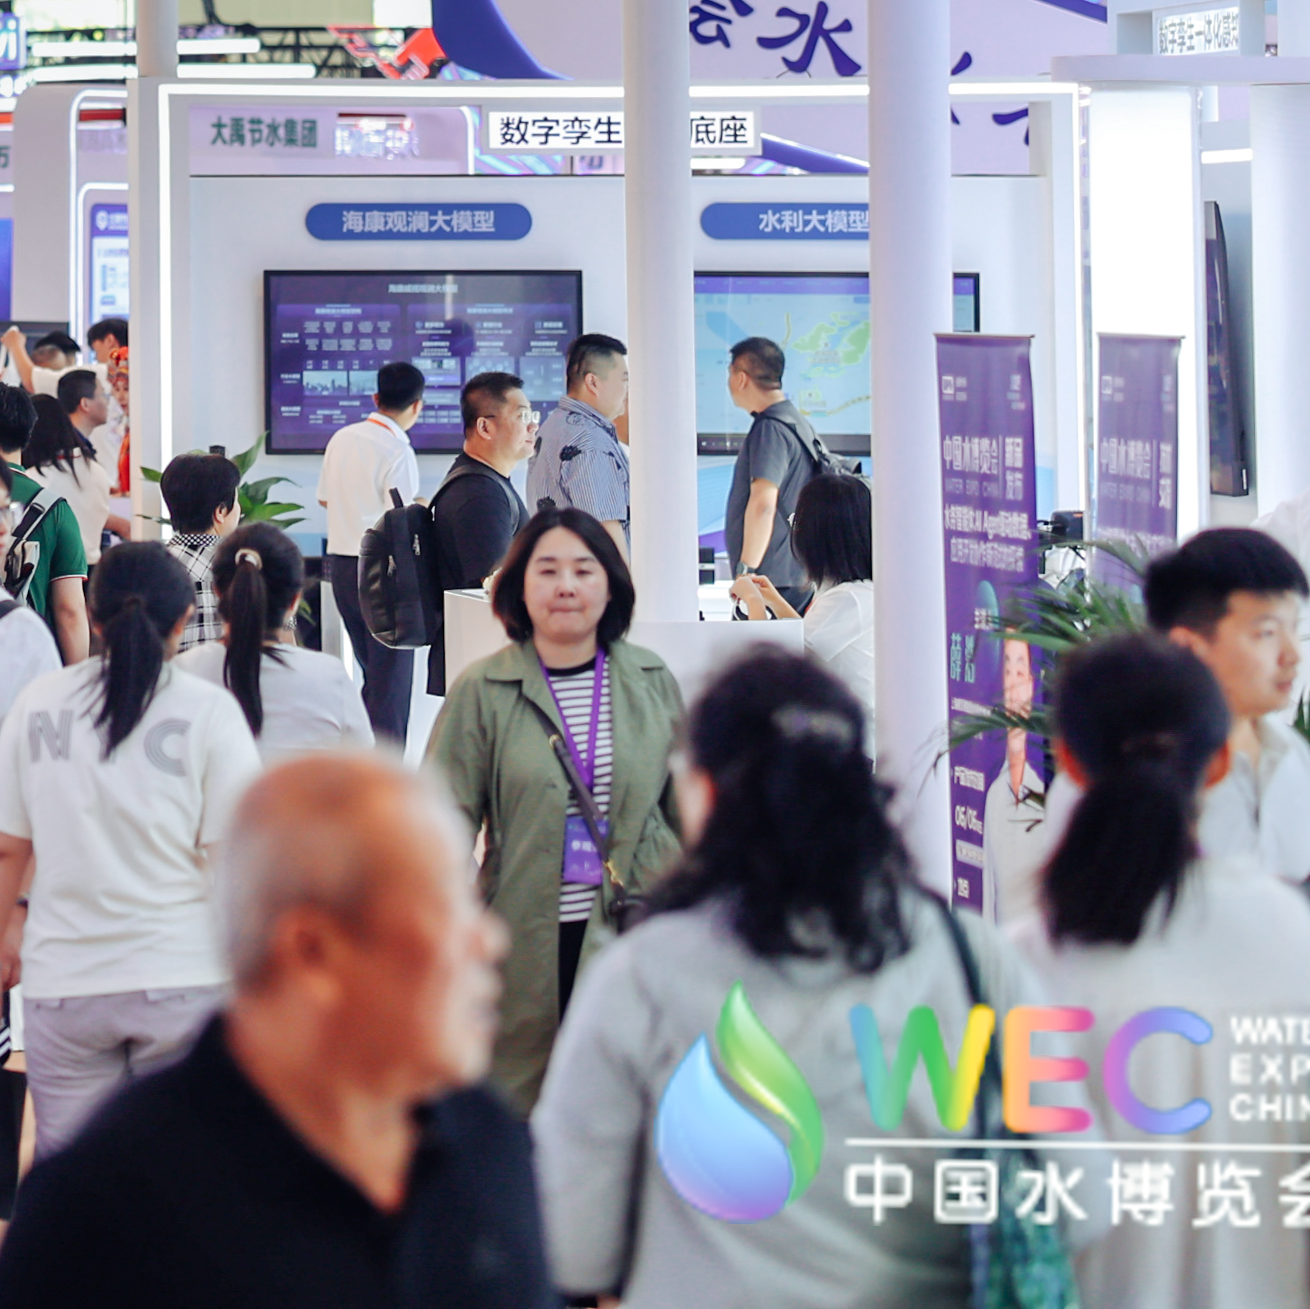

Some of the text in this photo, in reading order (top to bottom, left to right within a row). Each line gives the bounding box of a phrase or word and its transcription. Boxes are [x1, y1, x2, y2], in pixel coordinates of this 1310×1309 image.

[210, 115, 318, 150] 大禹节水集团
[341, 209, 496, 234] 海康观澜大模型
[758, 209, 870, 234] 水利大模型
